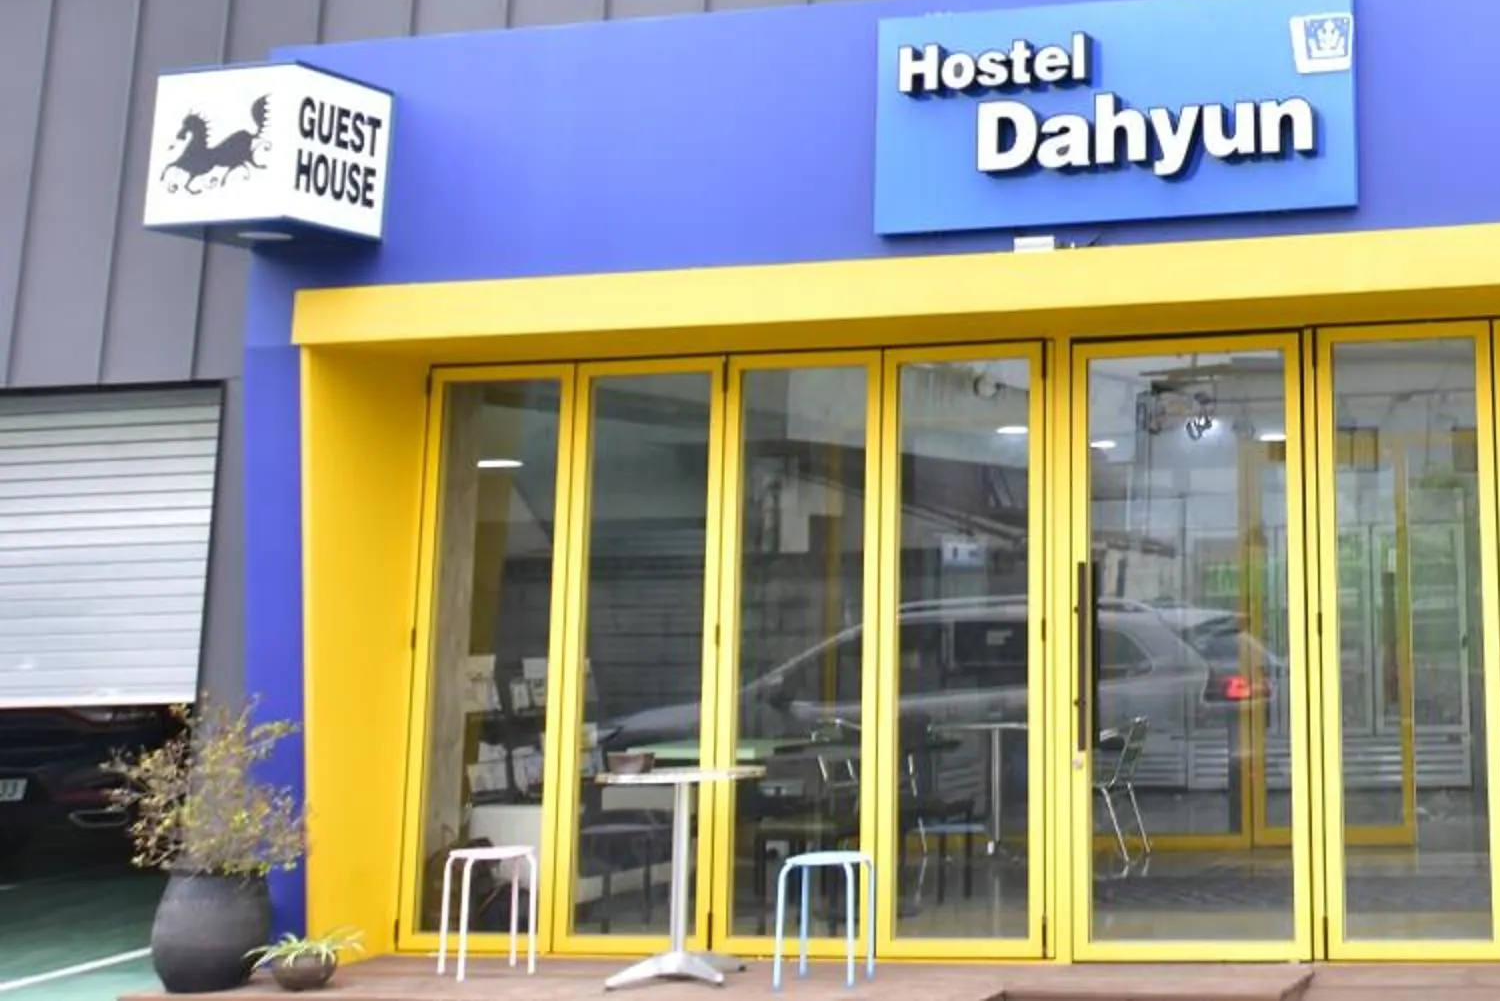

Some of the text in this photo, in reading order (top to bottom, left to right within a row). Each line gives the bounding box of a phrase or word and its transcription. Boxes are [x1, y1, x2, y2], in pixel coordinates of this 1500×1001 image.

[898, 31, 1090, 93] Hostel
[298, 96, 383, 157] GUEST
[975, 91, 1315, 176] Dahyun
[294, 148, 377, 209] HOUSE
